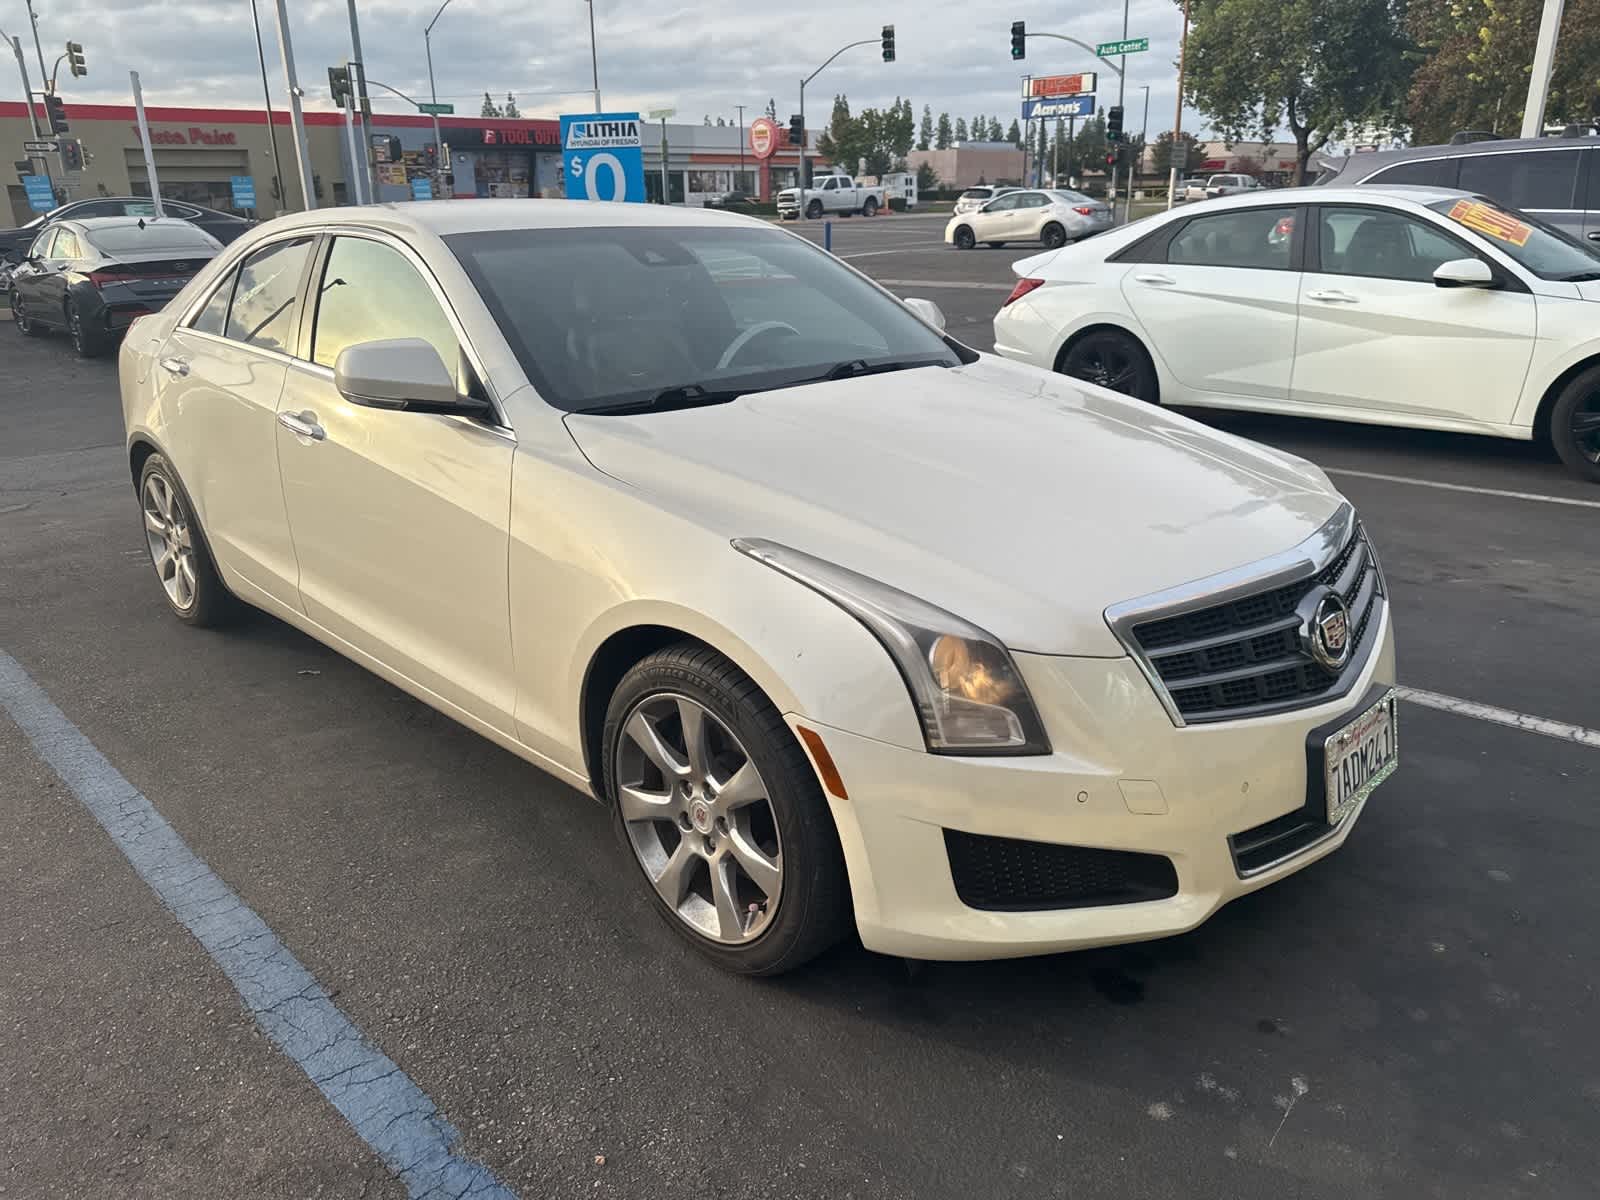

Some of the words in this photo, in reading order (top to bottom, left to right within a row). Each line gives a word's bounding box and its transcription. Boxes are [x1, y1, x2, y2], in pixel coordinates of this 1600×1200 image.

[1100, 45, 1117, 55] Auto
[1118, 42, 1142, 52] Center
[1030, 101, 1081, 117] Aaron's
[188, 127, 237, 145] Paint
[500, 128, 533, 145] TOOL
[587, 122, 638, 138] LITHIA
[570, 139, 600, 147] HYUNDAI
[601, 138, 610, 146] OF
[611, 138, 639, 146] FRESNO
[1332, 725, 1391, 803] 7ADM241
